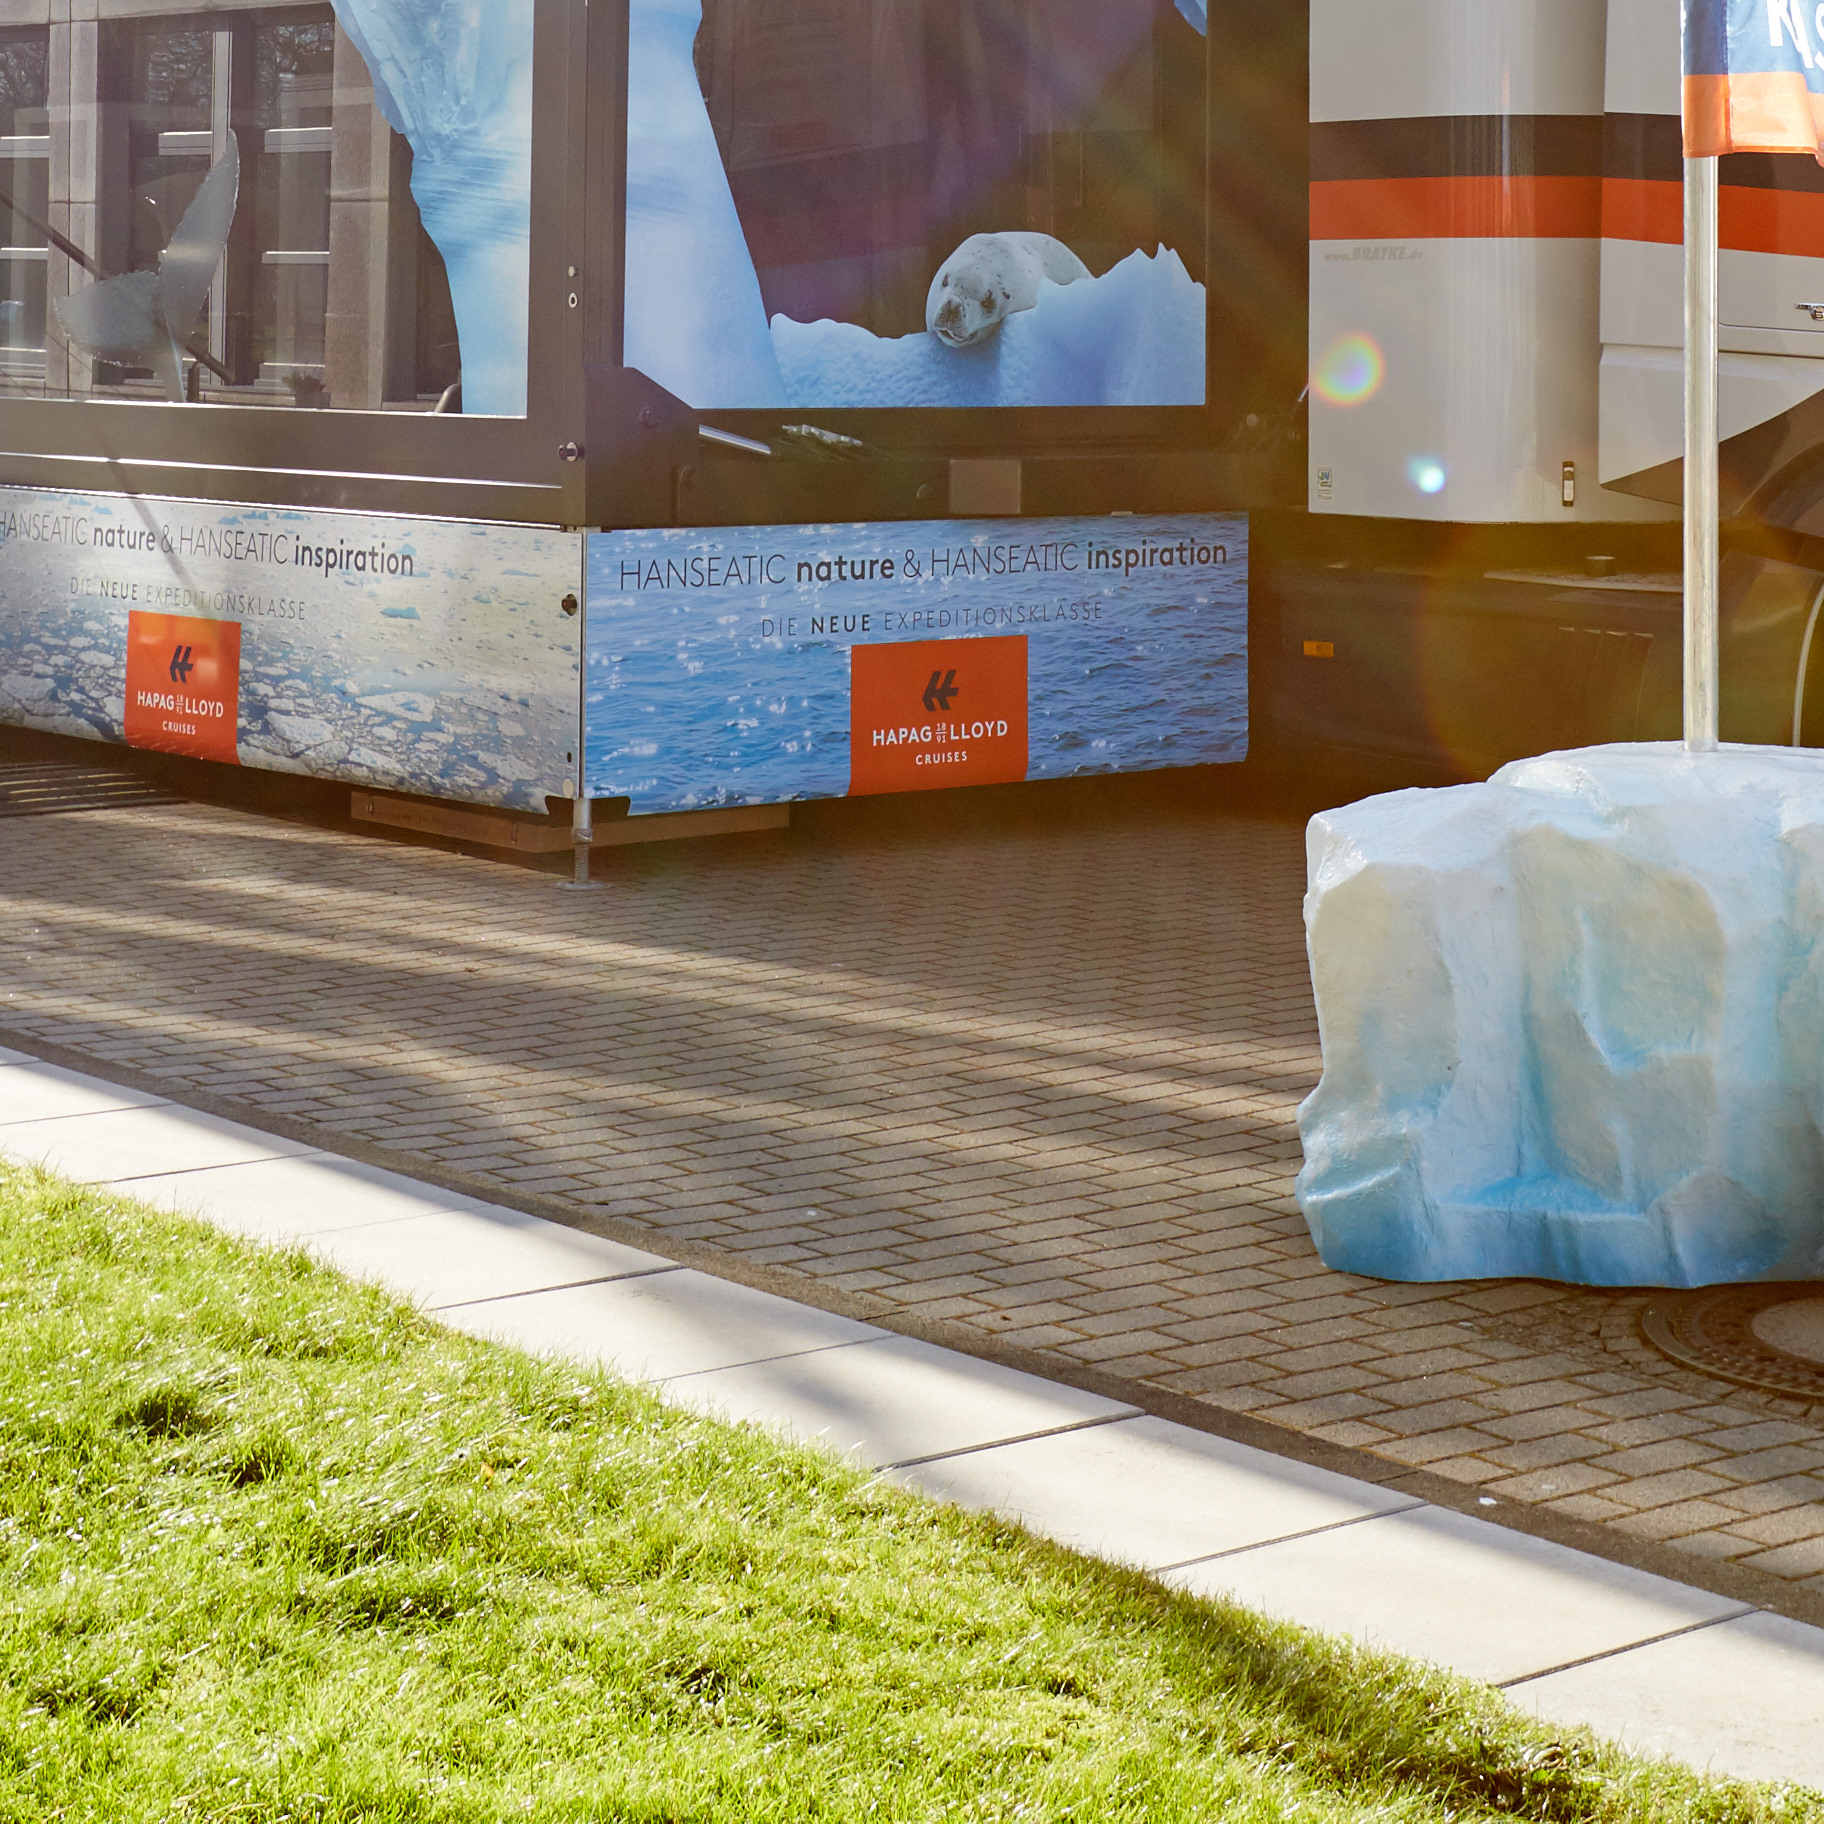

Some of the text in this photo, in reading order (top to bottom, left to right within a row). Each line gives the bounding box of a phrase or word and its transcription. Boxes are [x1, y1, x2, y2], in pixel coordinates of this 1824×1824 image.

[93, 524, 156, 551] nature
[160, 524, 174, 554] &
[179, 526, 288, 564] HANSEATIC
[294, 534, 414, 578] inspiration
[621, 537, 1227, 590] HANSEATIC nature & HANSEATIC inspiration
[70, 576, 306, 620] DIE NEUE EXPEDITIONSKLASSE
[762, 601, 1103, 638] DIE NEUE EXPEDITIONSKLASSE
[137, 690, 175, 711] HAPAG
[185, 697, 224, 718] LLOYD
[162, 720, 196, 735] CRUISES
[872, 725, 932, 747] HAPAG
[950, 720, 1008, 740] LLOYD
[915, 751, 968, 765] CRUISES
